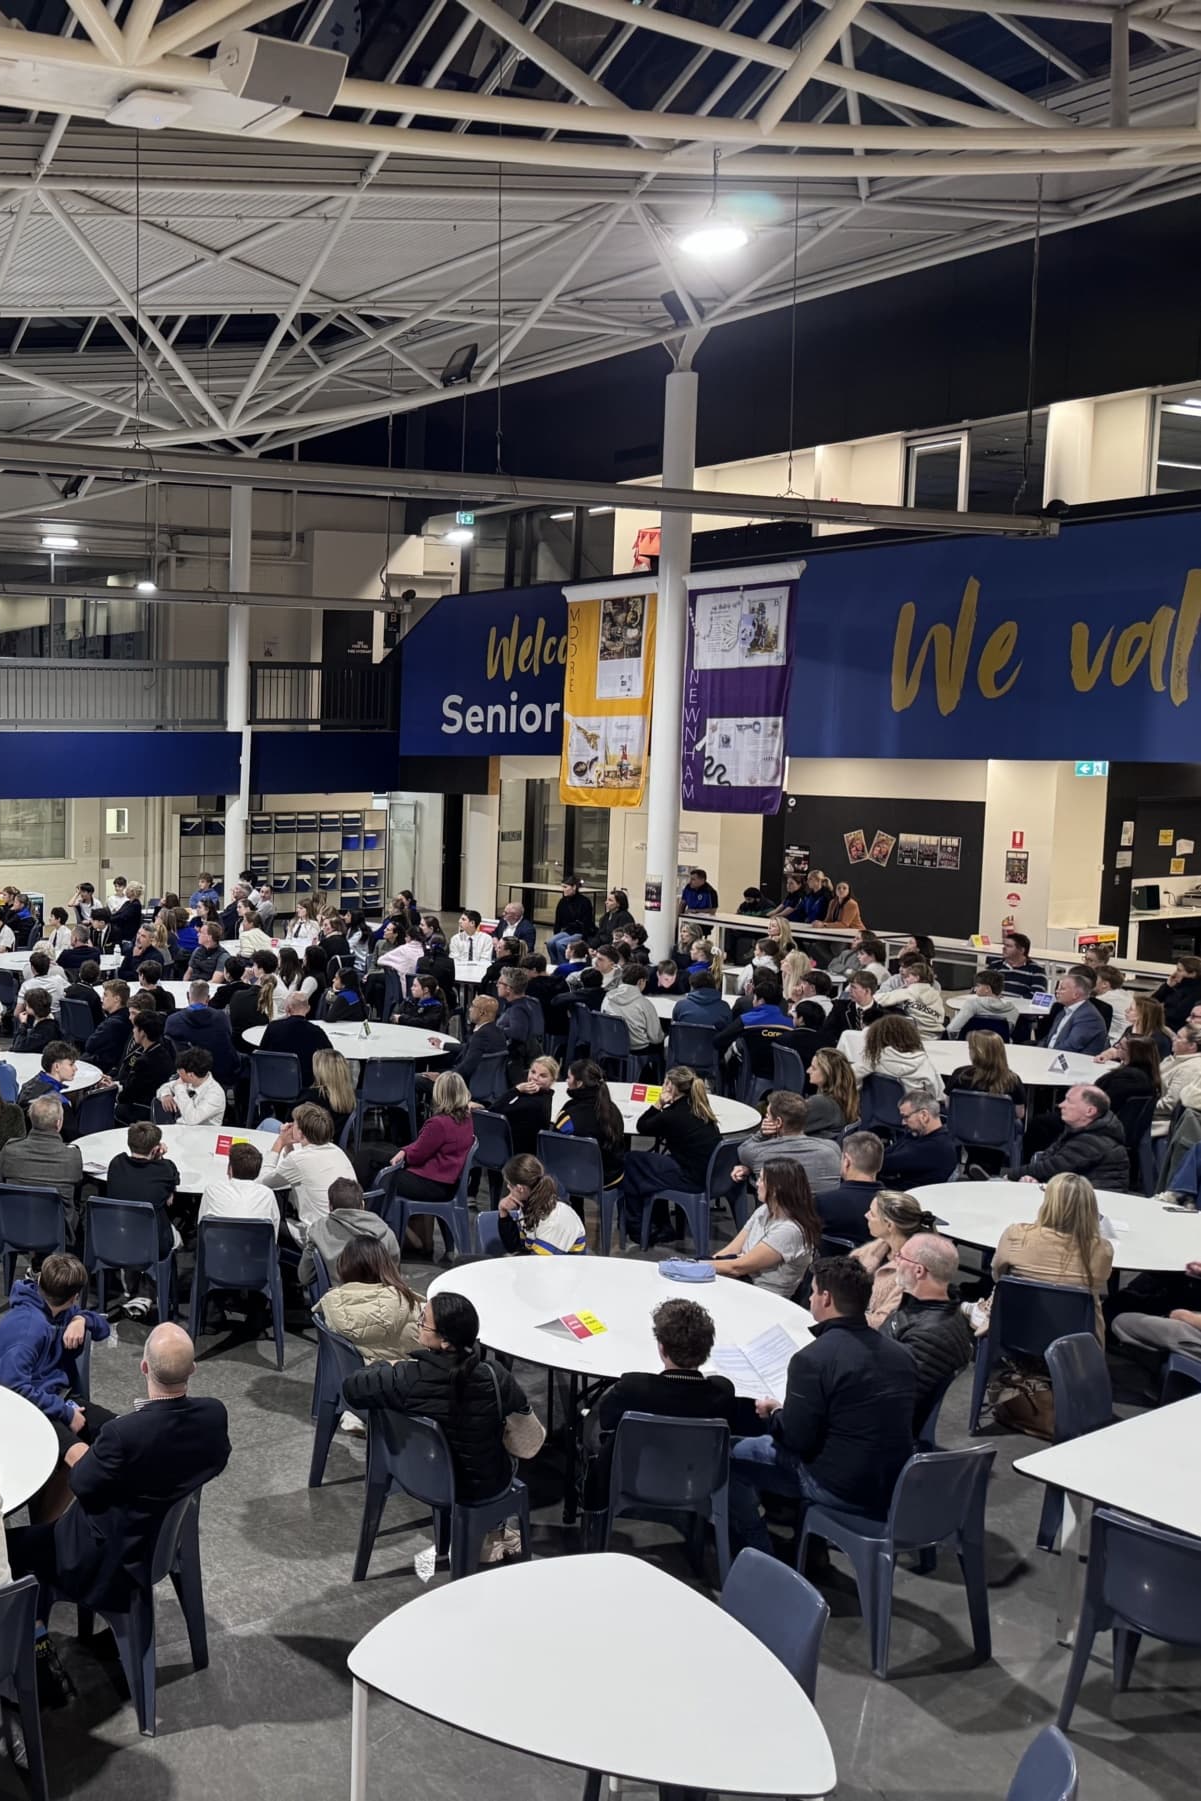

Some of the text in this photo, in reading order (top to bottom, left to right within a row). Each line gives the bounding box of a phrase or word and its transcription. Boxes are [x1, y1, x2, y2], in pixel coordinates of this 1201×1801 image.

[891, 576, 1023, 717] We
[441, 691, 560, 734] Senior
[682, 669, 701, 800] NEWNHAM
